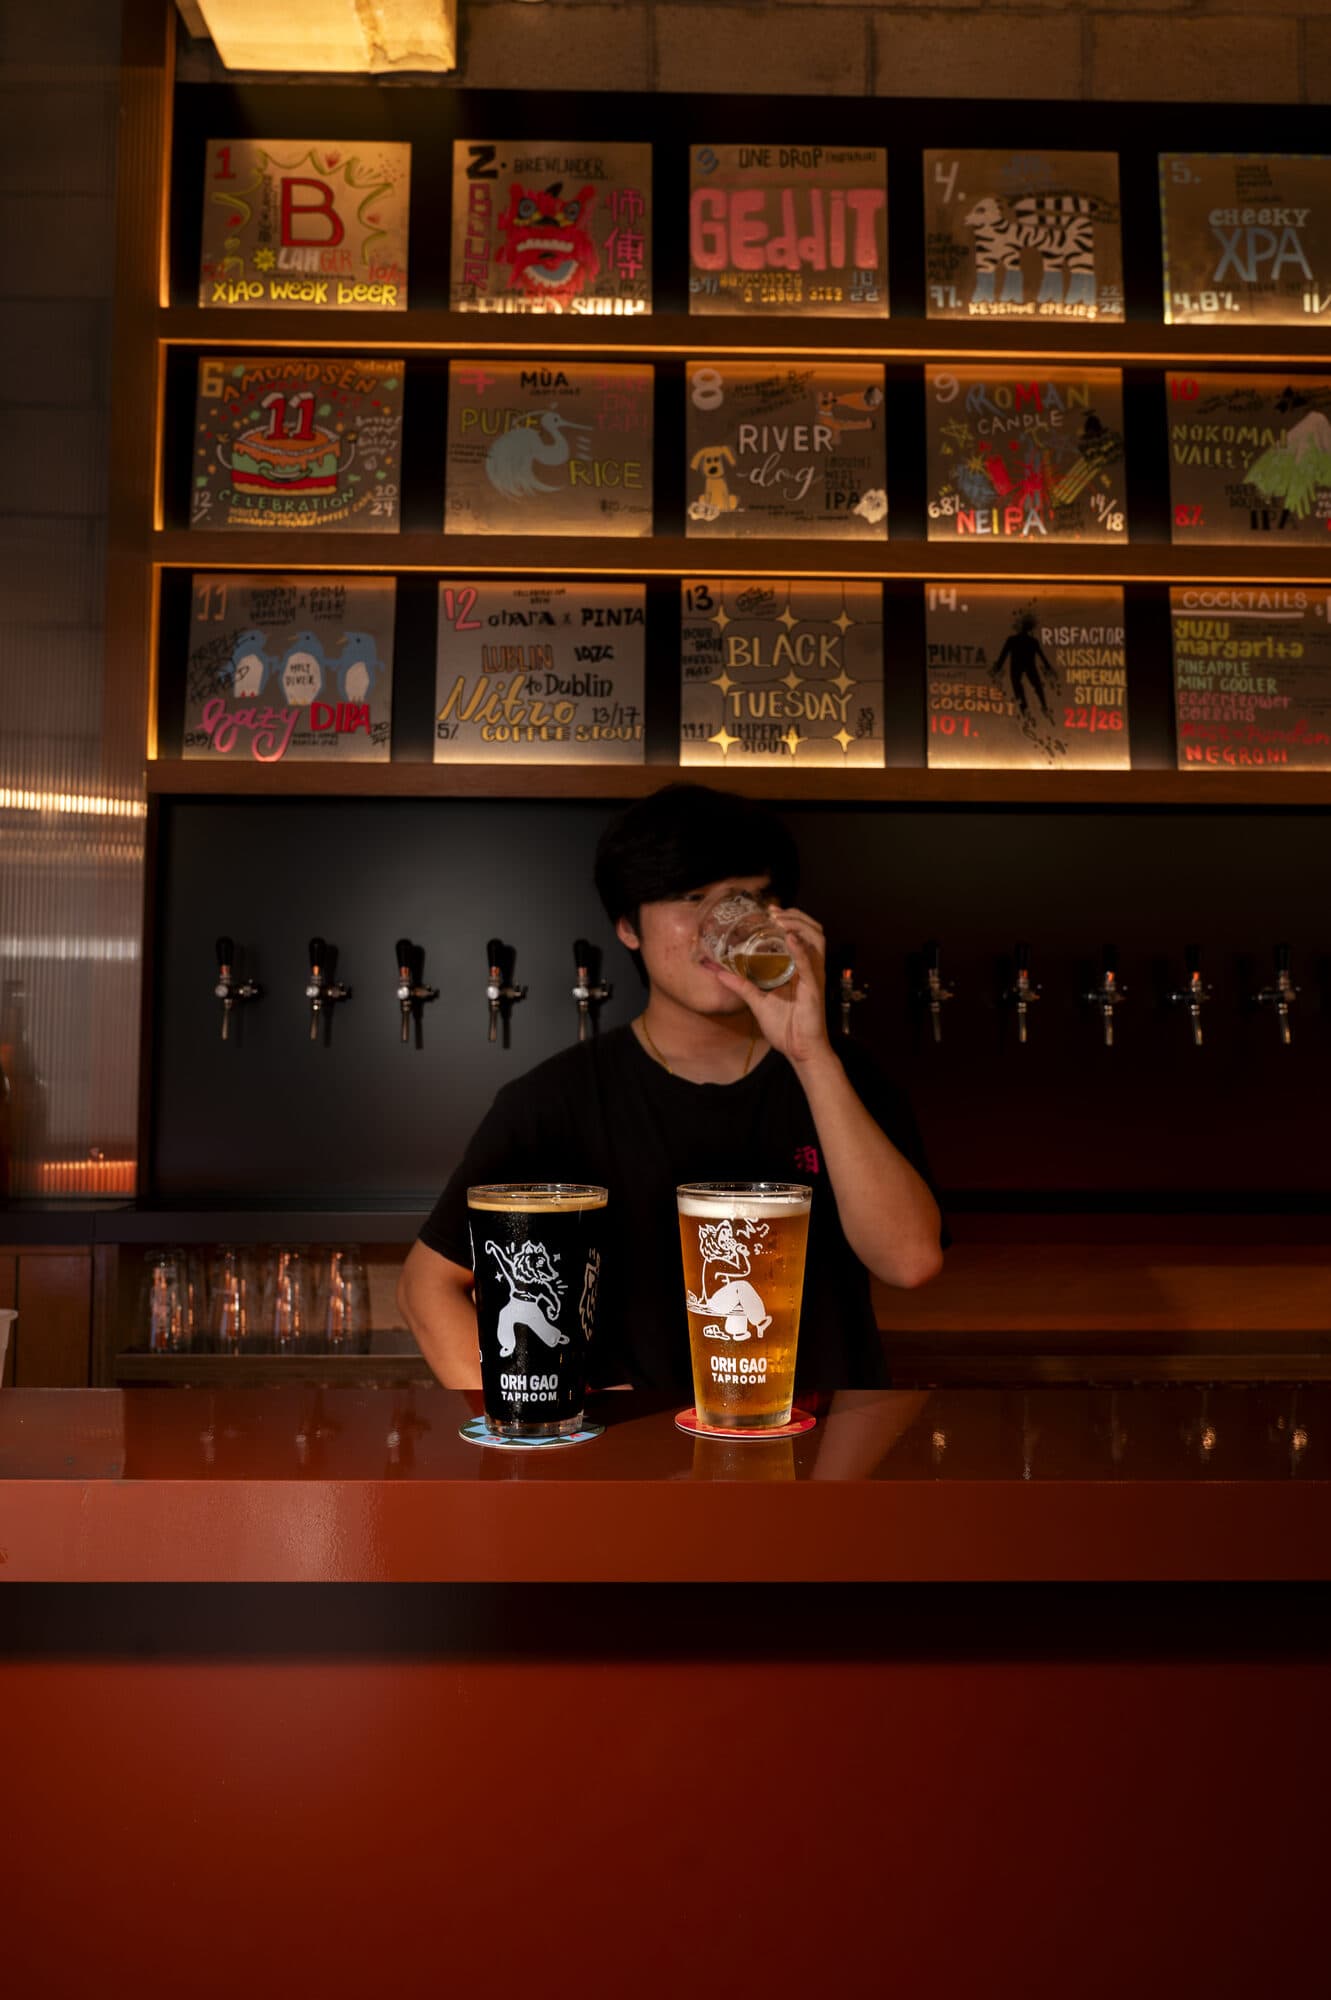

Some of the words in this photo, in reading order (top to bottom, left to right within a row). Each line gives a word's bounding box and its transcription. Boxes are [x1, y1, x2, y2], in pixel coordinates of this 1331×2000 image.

[213, 146, 237, 179] 1
[779, 147, 823, 168] DROP
[280, 177, 345, 246] B
[1209, 226, 1314, 283] XPA
[1039, 303, 1098, 319] SPECIES
[1173, 292, 1240, 313] 4.8%
[201, 361, 224, 398] 6
[223, 363, 377, 403] AMUNDSEN
[691, 367, 724, 411] 8
[933, 372, 960, 403] 9
[1171, 378, 1200, 401] 10
[965, 381, 1090, 416] ROMAN
[261, 392, 315, 440] 11
[977, 410, 1065, 434] CANDLE
[738, 424, 833, 454] RIVER
[1172, 443, 1254, 470] VALLEY
[568, 459, 643, 489] RICE
[744, 451, 818, 502] dog
[218, 488, 354, 511] CELEBRATION
[825, 492, 861, 510] IPA
[1250, 509, 1298, 530] IPA
[196, 584, 228, 621] 11
[444, 588, 481, 631] 12
[686, 585, 713, 611] 13
[1182, 591, 1308, 609] COCKTAILS
[581, 608, 644, 627] PINTA
[1041, 626, 1125, 646] RISFACTOR
[1176, 636, 1304, 658] margarita
[726, 632, 842, 669] BLACK
[928, 645, 986, 664] PINTA
[1055, 647, 1125, 666] RUSSIAN
[1066, 668, 1127, 687] IMPERIAL
[1177, 659, 1251, 677] PINEAPPLE
[525, 677, 541, 694] to
[544, 673, 614, 697] Dublin
[929, 683, 1003, 701] COFFEE
[1074, 686, 1126, 706] STOUT
[1177, 676, 1213, 690] MINT
[1219, 677, 1278, 695] COOLER
[438, 674, 577, 727] Nitro
[729, 689, 853, 723] TUESDAY
[929, 697, 1016, 716] COCONUT
[310, 702, 371, 735] DIPA
[592, 702, 640, 726] 13/17
[1063, 706, 1123, 733] 22/26
[740, 739, 787, 755] STOUT
[1185, 745, 1288, 765] NEGRONI
[710, 1356, 737, 1373] ORH
[739, 1356, 768, 1373] GAO
[500, 1374, 527, 1391] ORH
[529, 1374, 558, 1391] GAO
[711, 1373, 766, 1384] TAPROOM
[501, 1391, 557, 1402] TAPROOM
